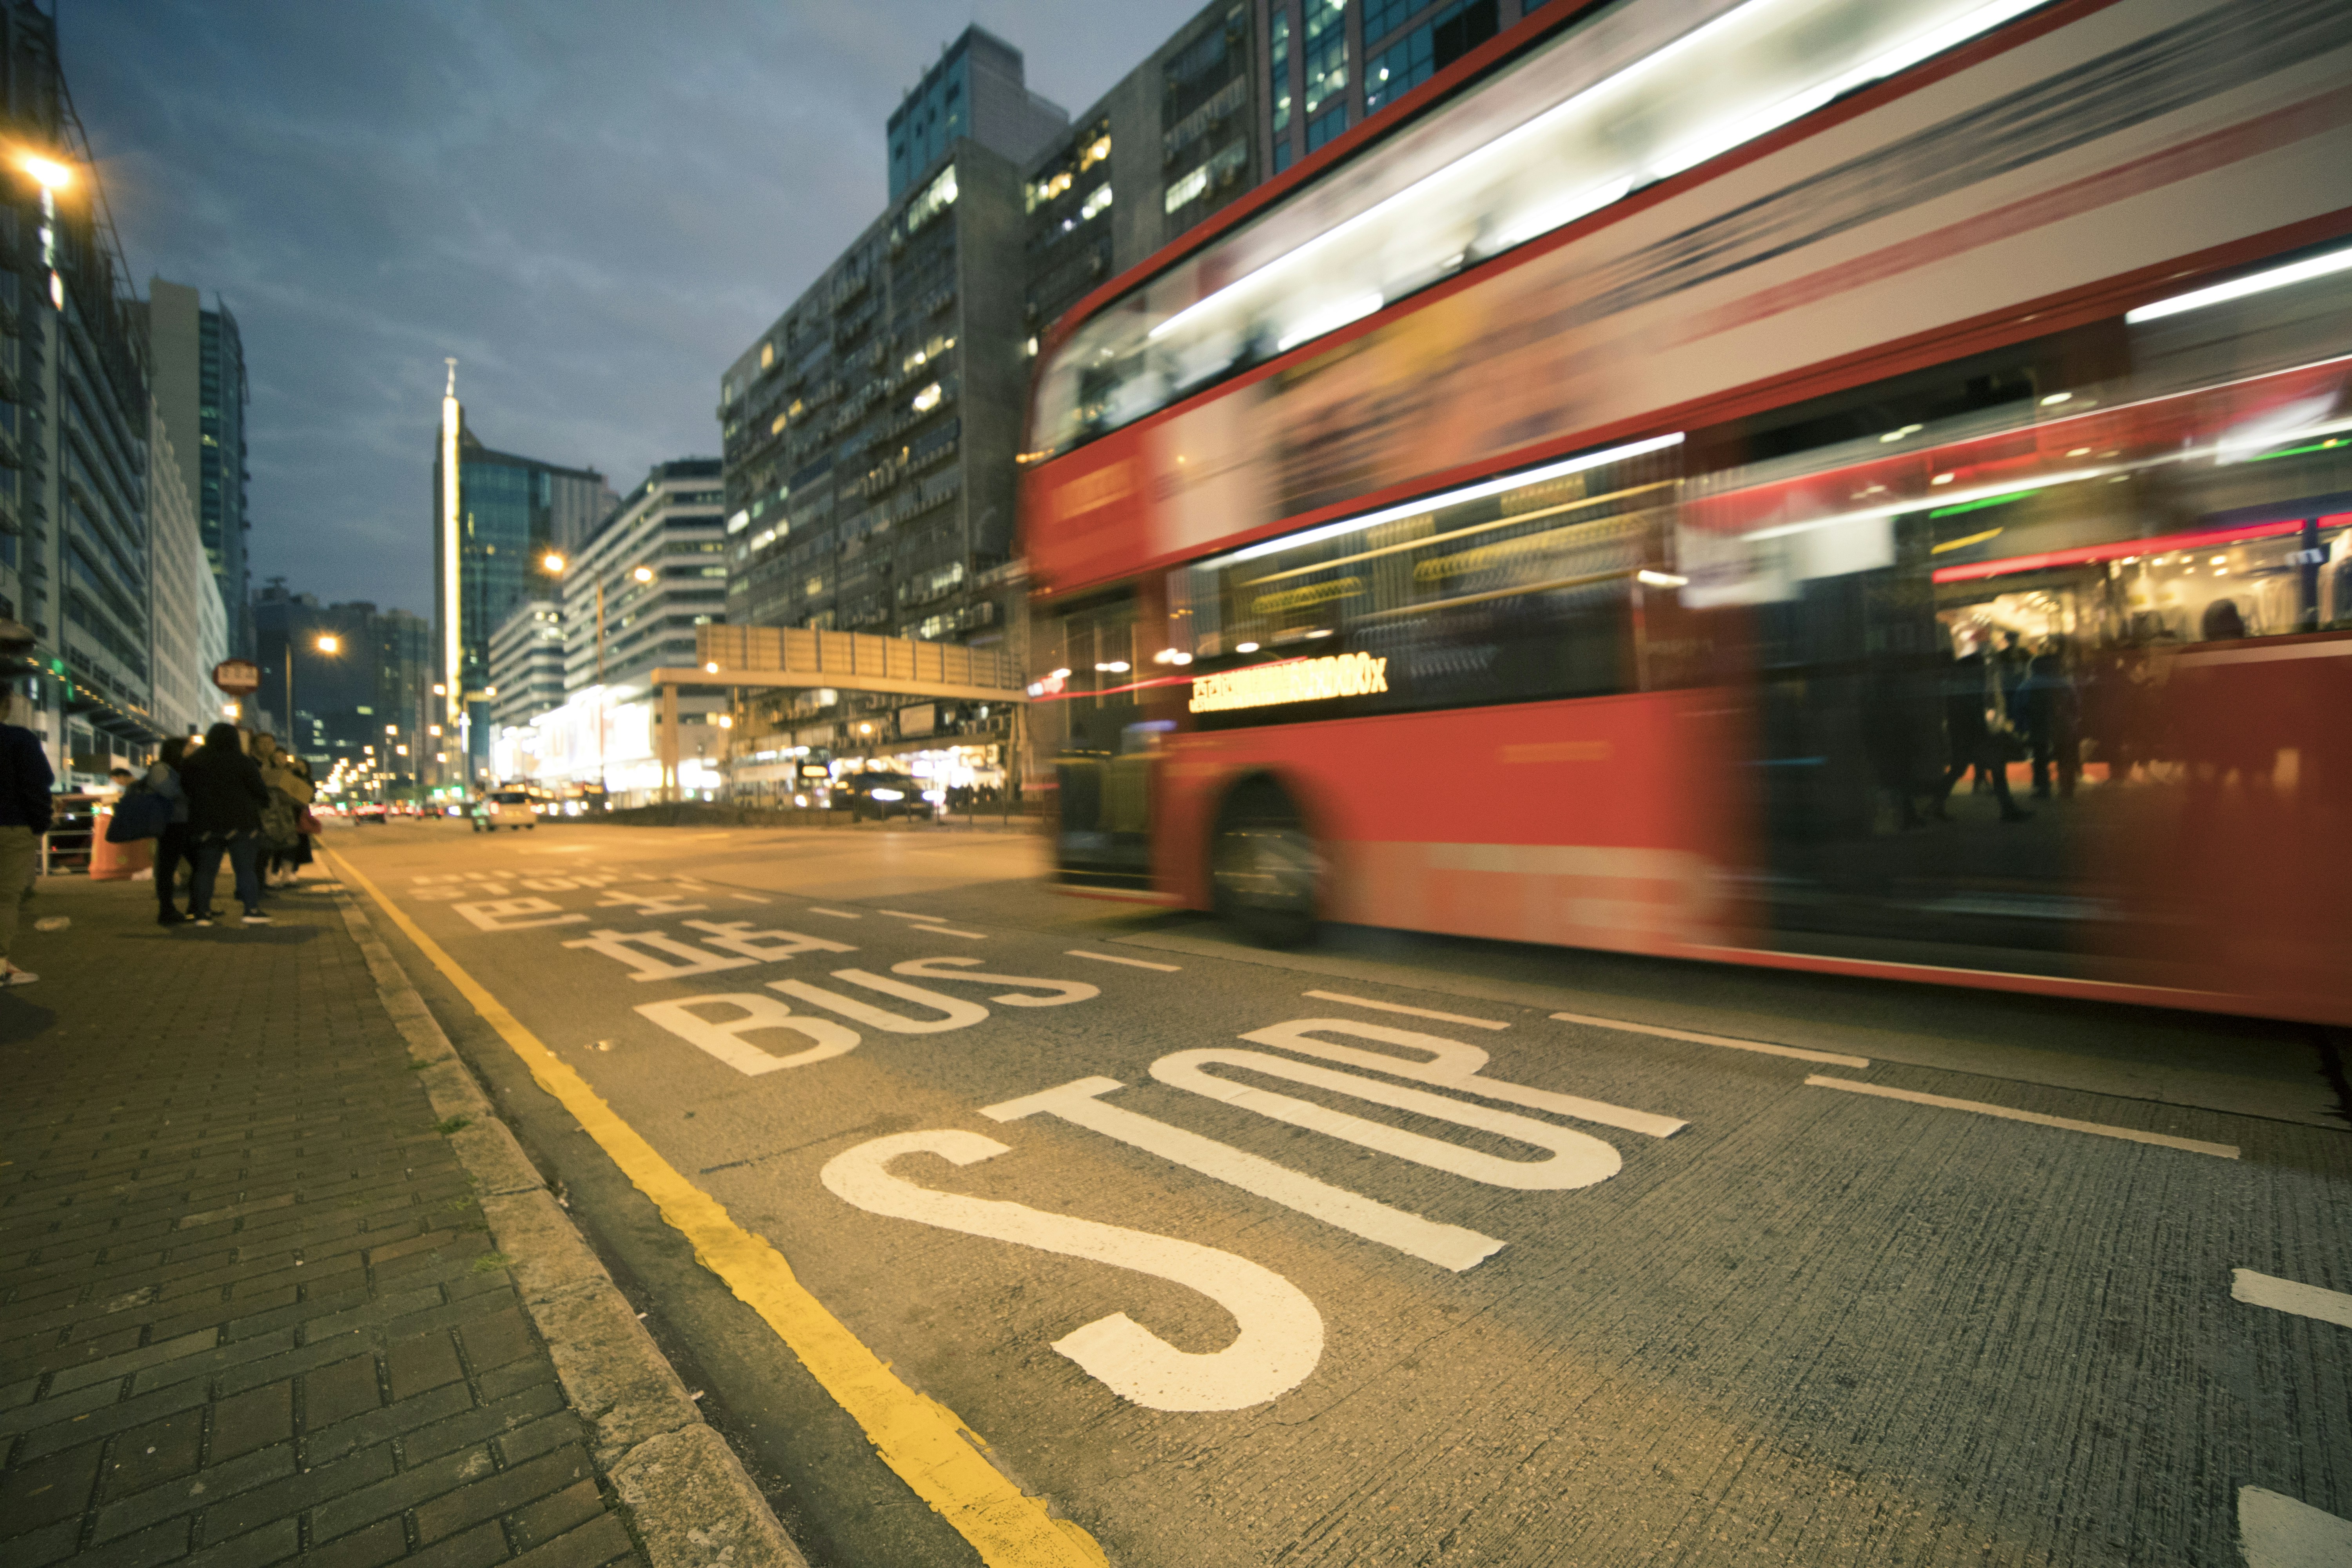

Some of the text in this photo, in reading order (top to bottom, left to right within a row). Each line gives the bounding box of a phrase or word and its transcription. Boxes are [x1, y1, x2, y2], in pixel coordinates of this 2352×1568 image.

[451, 890, 710, 931] 巴士
[560, 919, 861, 982] 站
[633, 956, 1102, 1077] BUS
[820, 1018, 1690, 1413] STOP
